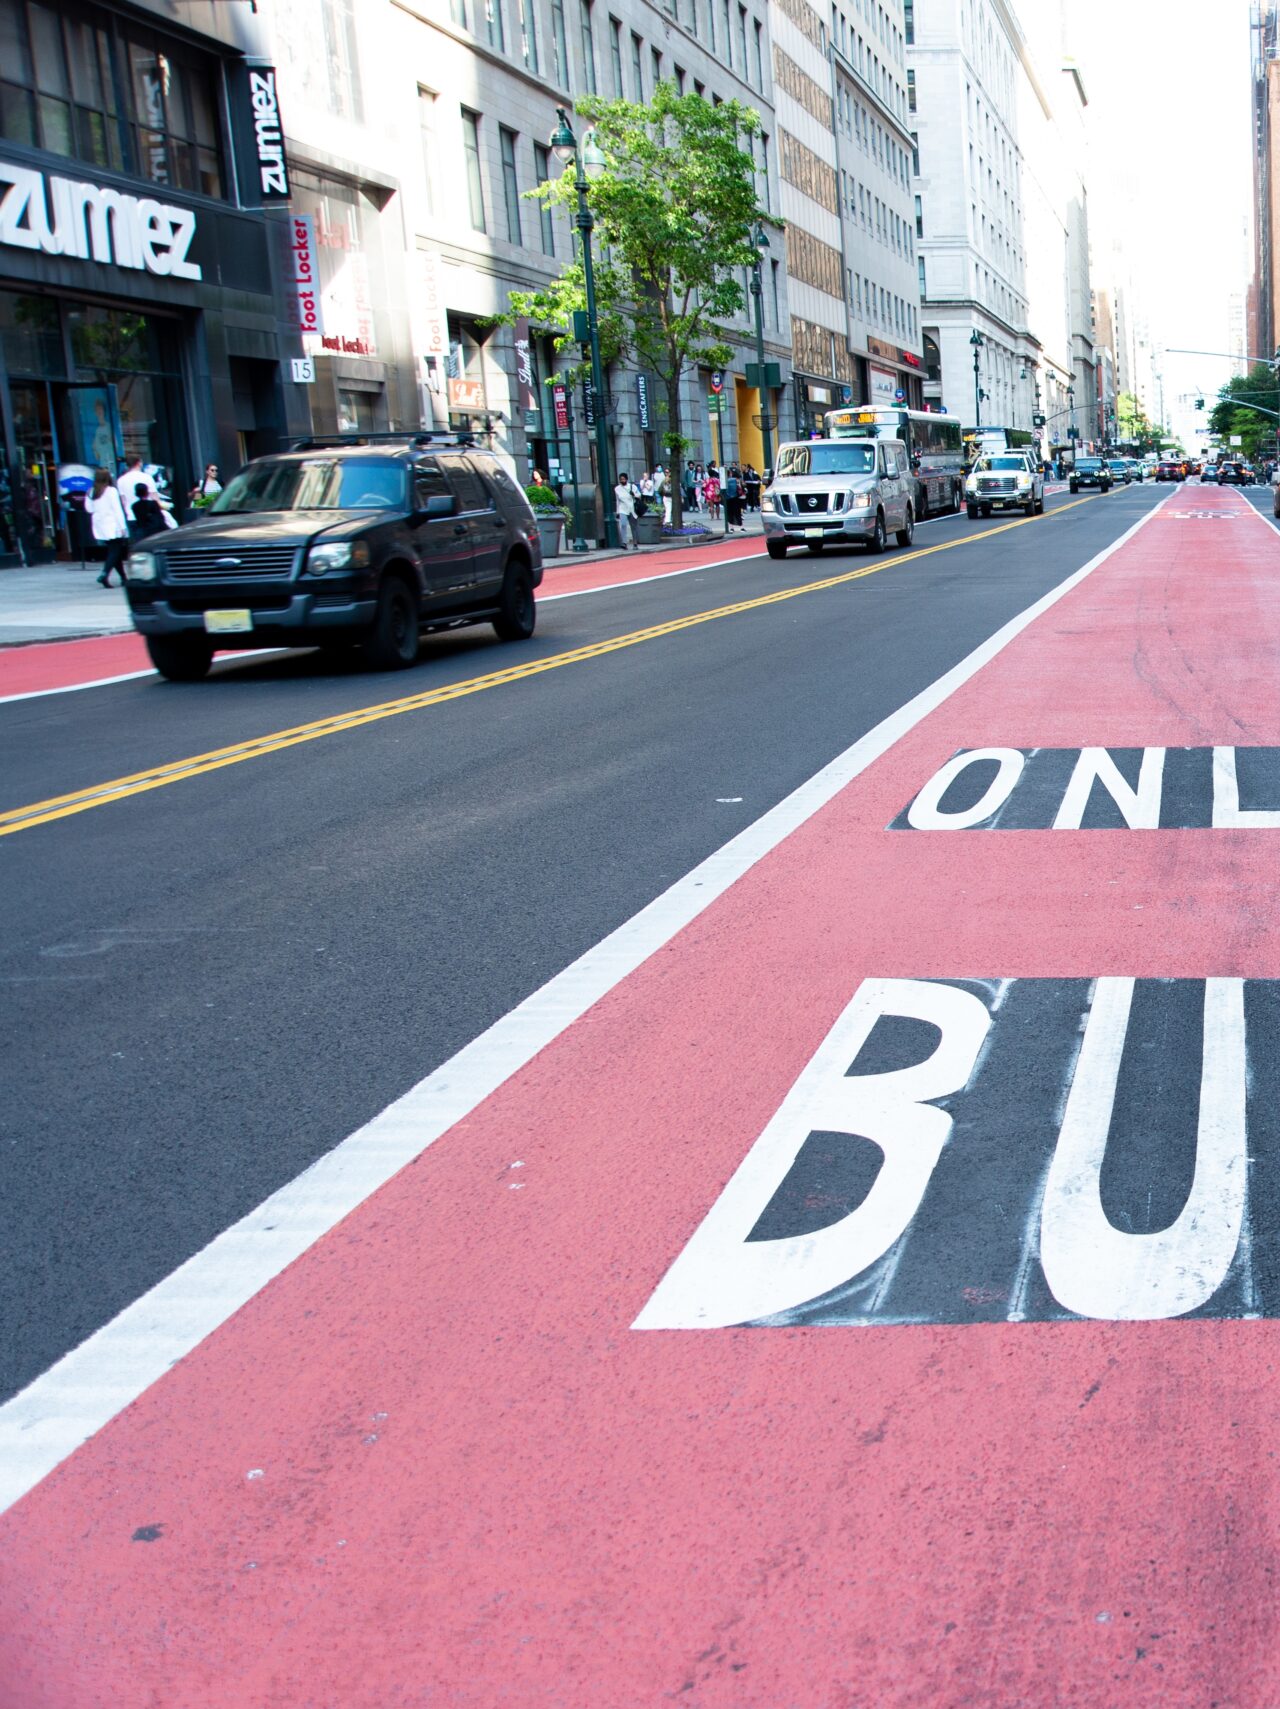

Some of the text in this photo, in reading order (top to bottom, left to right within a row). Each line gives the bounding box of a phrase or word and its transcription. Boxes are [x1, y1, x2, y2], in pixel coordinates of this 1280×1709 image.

[249, 72, 288, 194] zumiez
[0, 162, 202, 281] zumiez
[292, 219, 318, 332] Foot Locker
[294, 362, 311, 380] 15
[638, 376, 649, 428] LENSCRAFTERS
